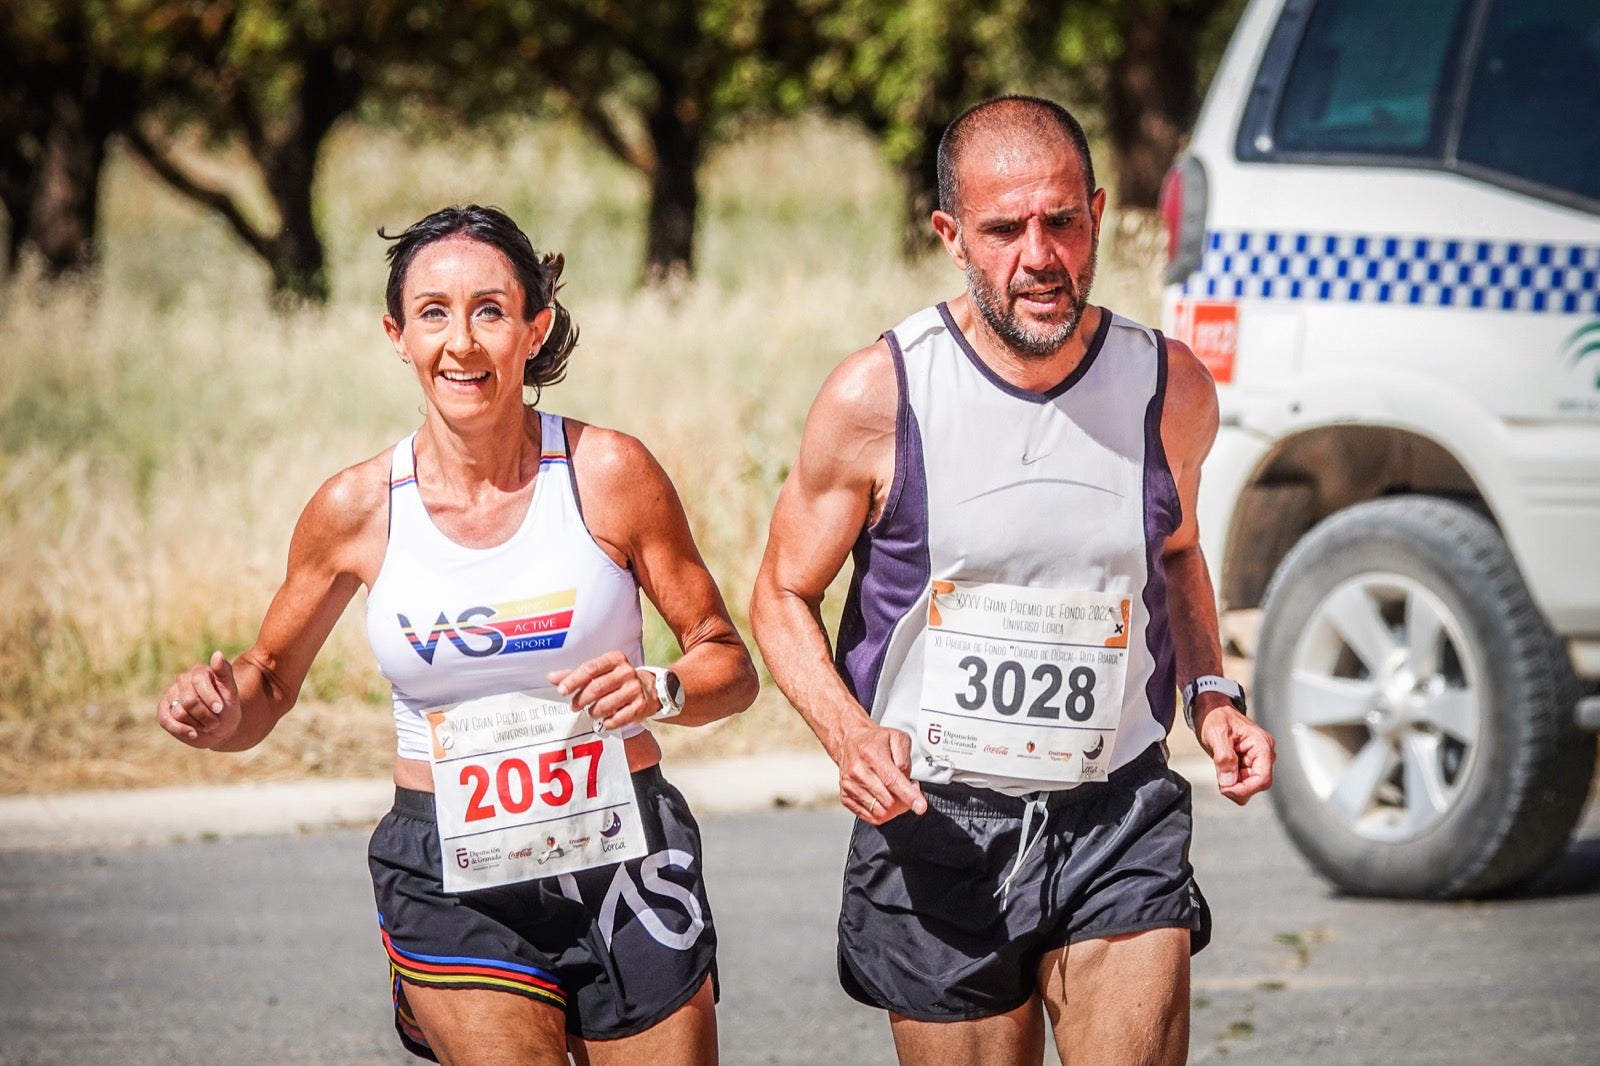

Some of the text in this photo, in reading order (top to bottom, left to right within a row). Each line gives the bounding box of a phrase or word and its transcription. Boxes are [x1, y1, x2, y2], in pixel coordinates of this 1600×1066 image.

[1010, 600, 1042, 617] PREMIO
[1046, 604, 1056, 618] DE
[1060, 603, 1085, 620] FONDO
[514, 618, 557, 633] ACTIVE
[1003, 617, 1064, 635] UNIVERSO LORCA
[514, 637, 553, 650] SPORT
[985, 642, 1006, 656] FONDO
[955, 656, 1096, 722] 3028
[496, 711, 527, 727] PREMIO
[493, 722, 554, 743] UNIVERSO LORCA
[943, 730, 978, 742] Diputación
[950, 740, 977, 749] Granada
[460, 740, 604, 823] 2057
[478, 854, 501, 864] Granada
